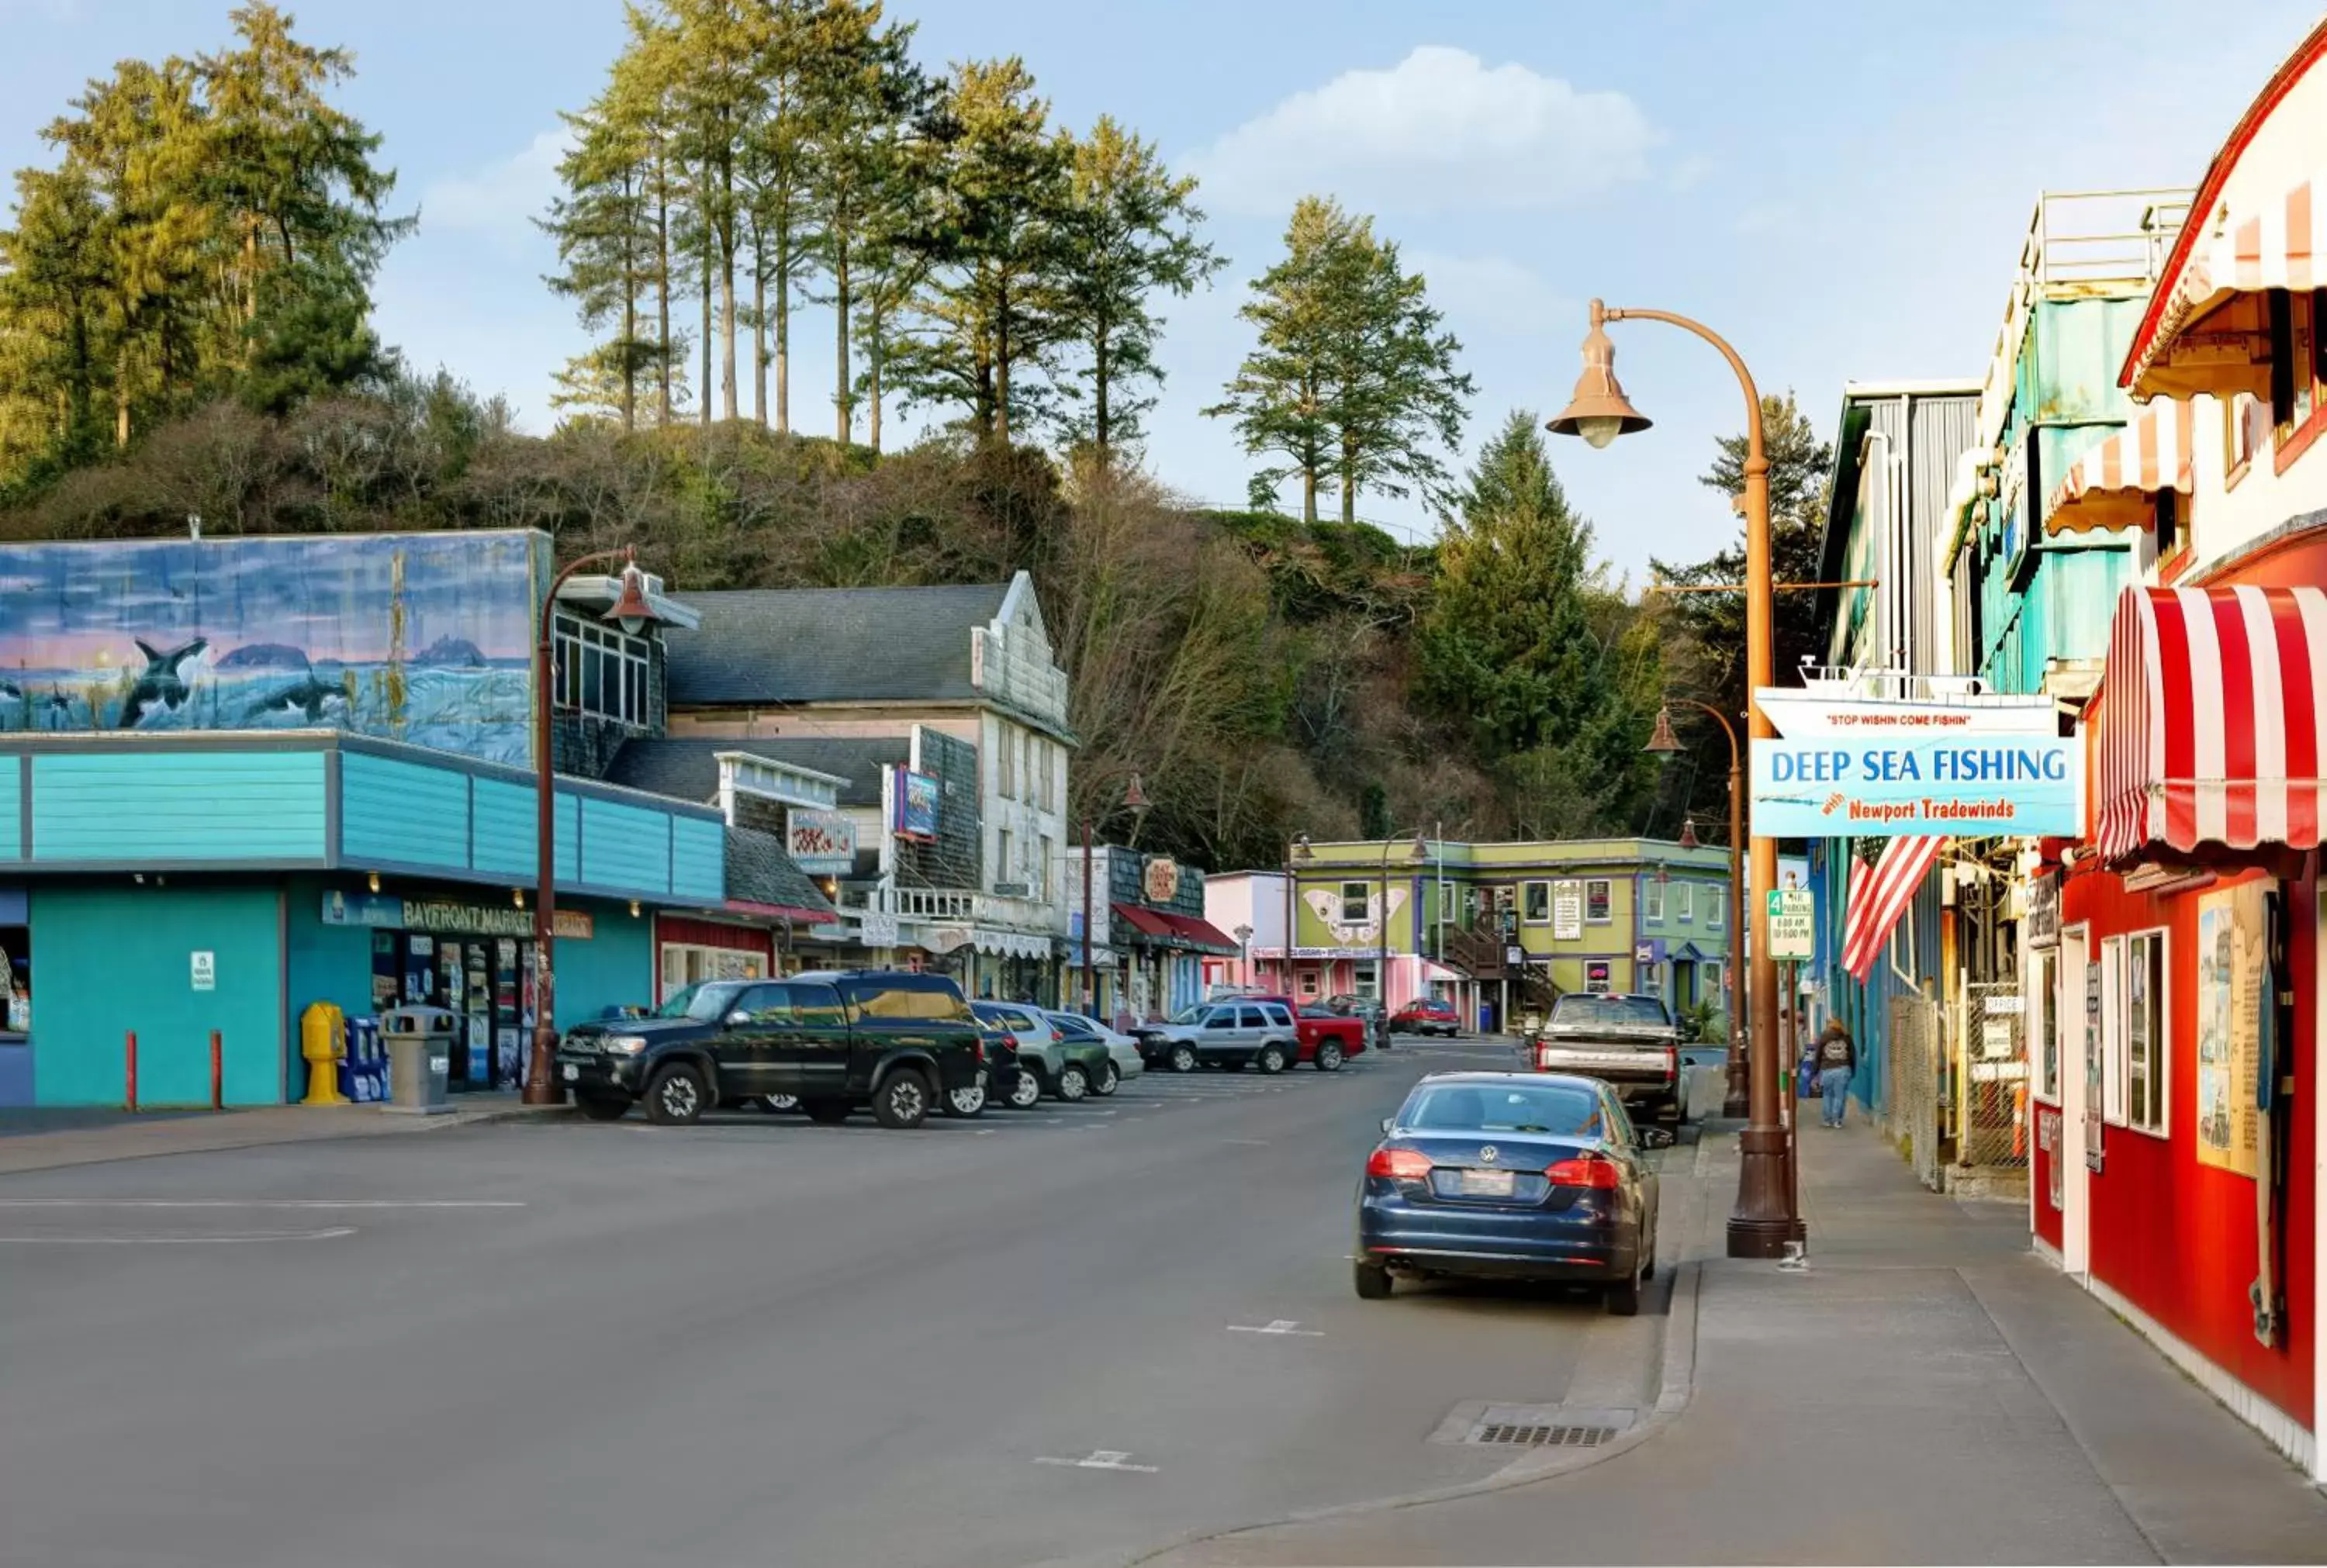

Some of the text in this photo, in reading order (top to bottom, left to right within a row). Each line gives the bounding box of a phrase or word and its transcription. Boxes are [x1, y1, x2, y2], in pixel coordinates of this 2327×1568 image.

[1827, 715, 1971, 725] "STOP WISHIN COME FISHIN"
[1772, 749, 2066, 782] DEEP SEA FISHING
[1820, 792, 1845, 815] with
[1849, 798, 2014, 823] Newport Tradewinds
[1770, 894, 1780, 913] 4
[1783, 903, 1811, 913] PARKING
[403, 900, 479, 928] BAYFRONT
[482, 908, 535, 935] MARKET
[1794, 917, 1805, 927] AM
[1799, 929, 1810, 938] PM
[1988, 997, 2018, 1009] OFFICE
